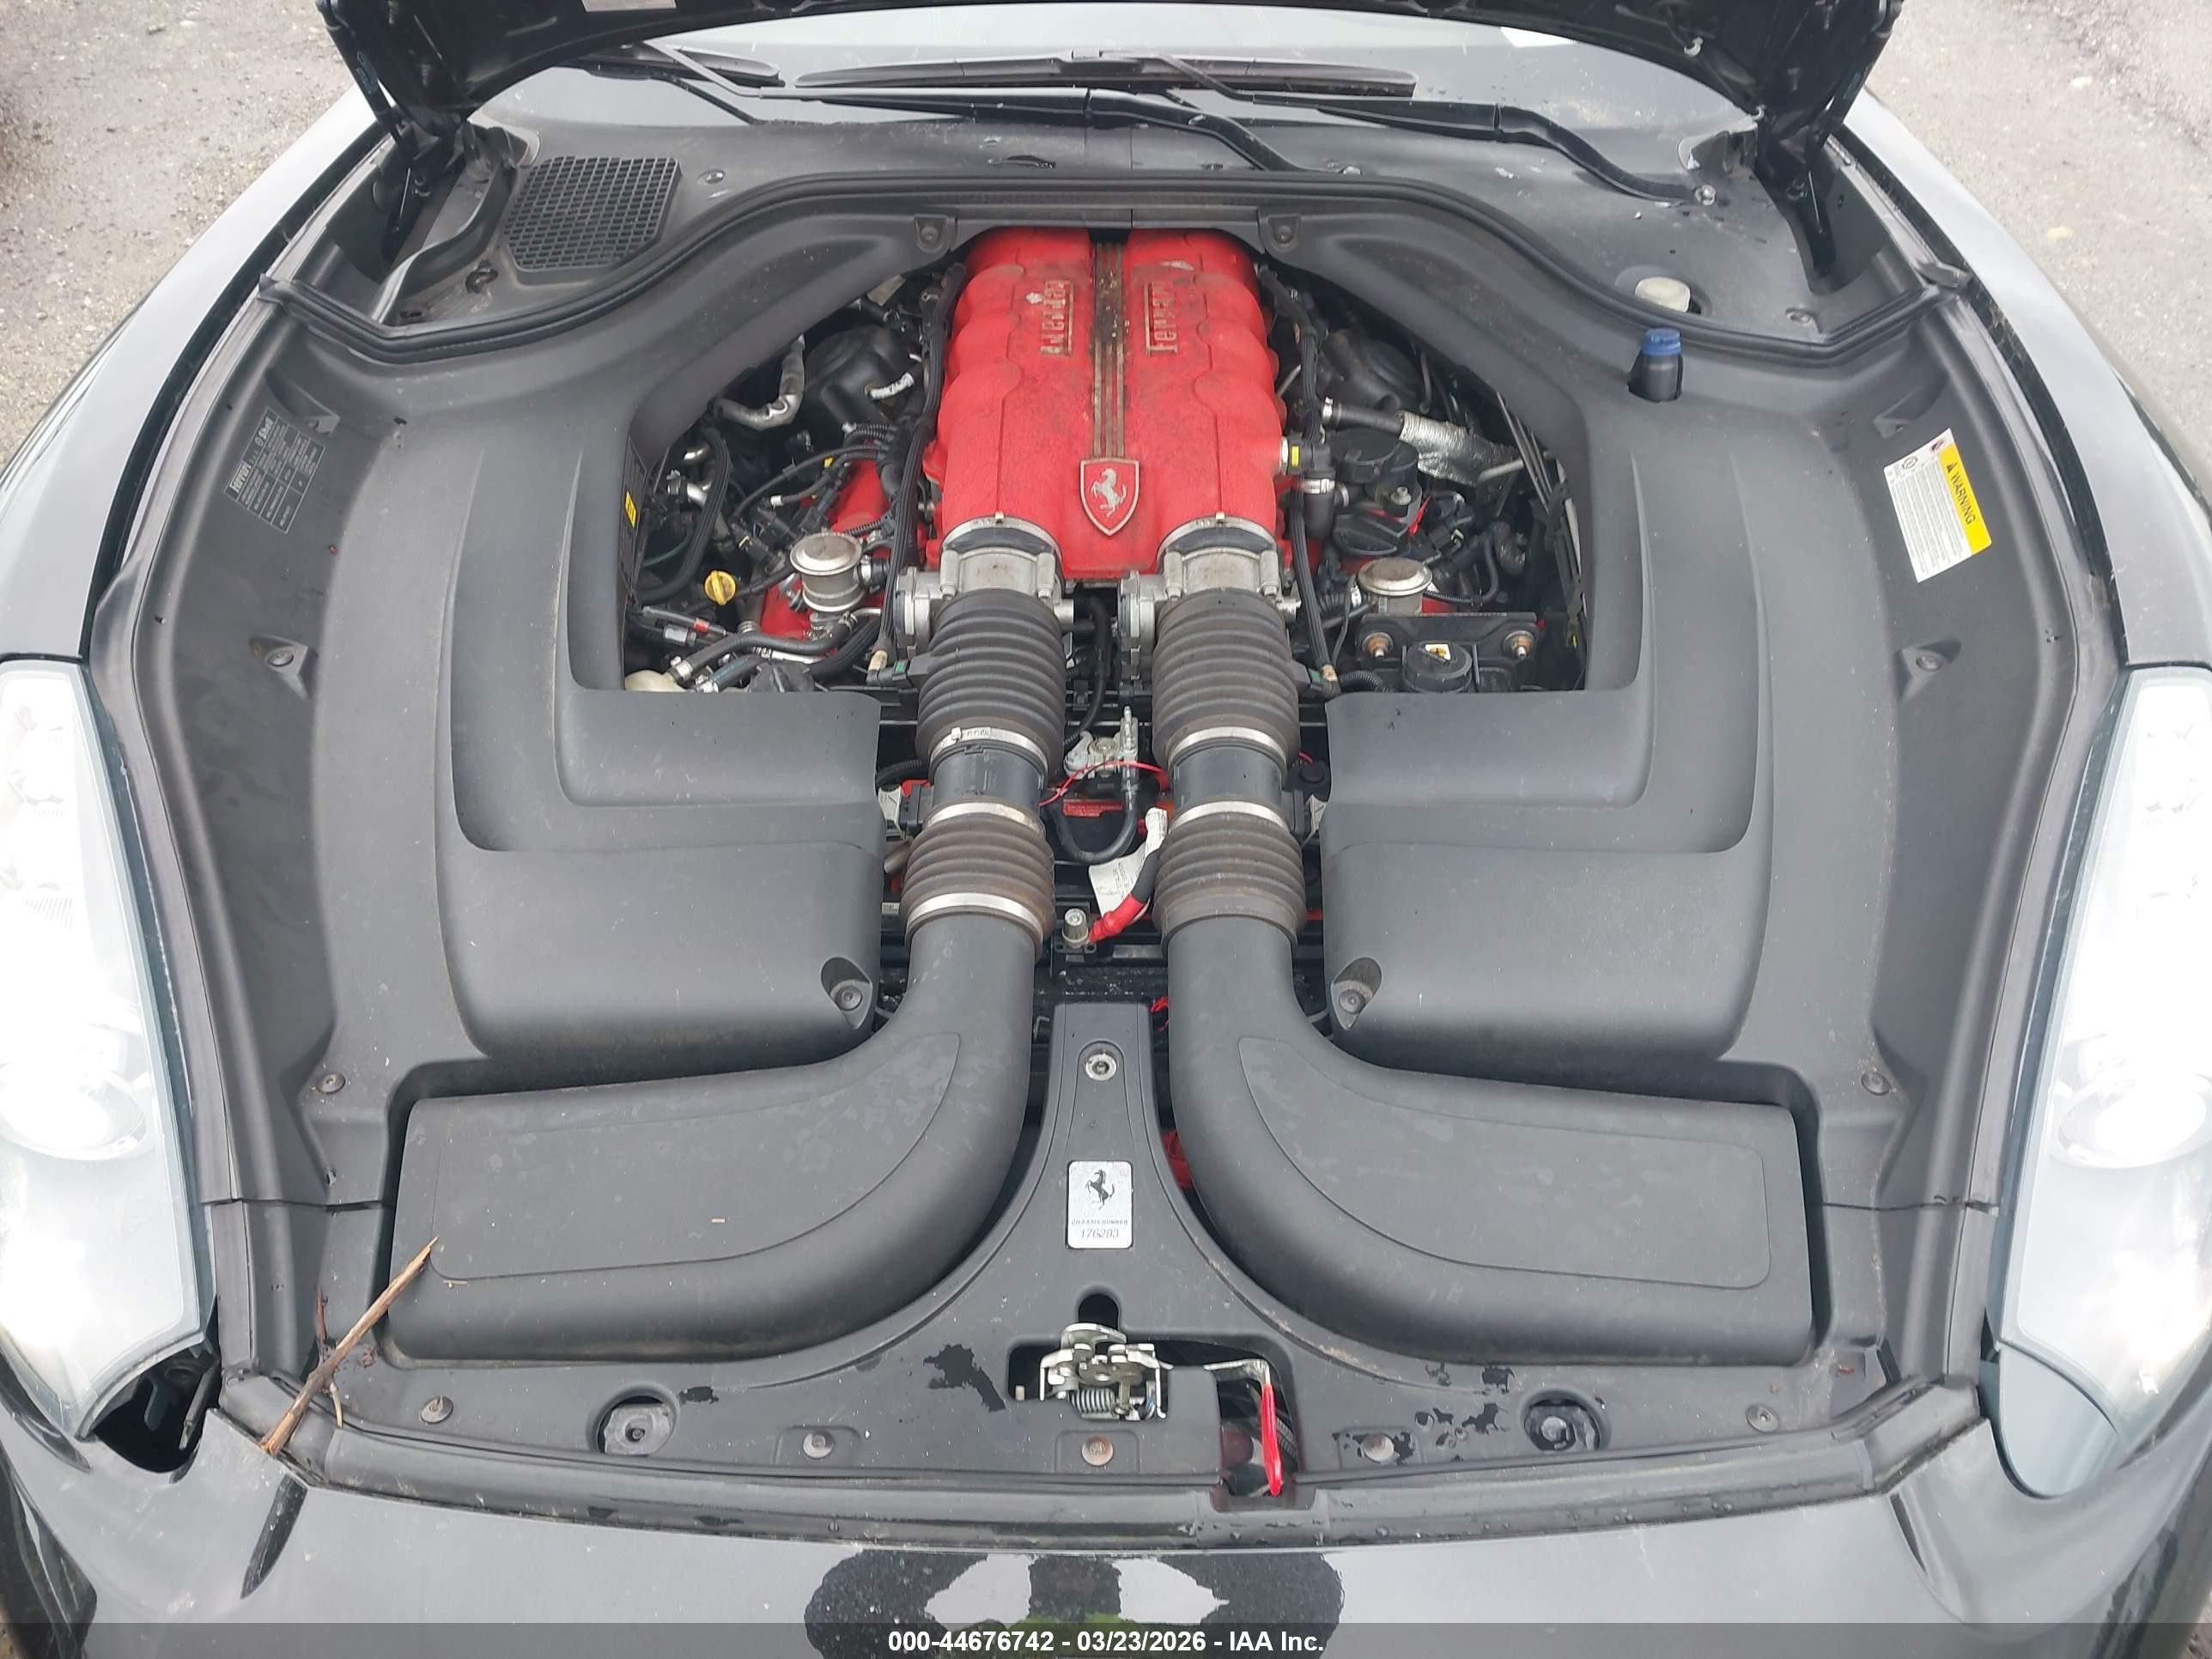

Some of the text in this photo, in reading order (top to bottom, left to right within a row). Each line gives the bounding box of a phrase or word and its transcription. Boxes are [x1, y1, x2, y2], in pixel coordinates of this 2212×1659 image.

[1040, 280, 1073, 356] Ferrari
[1145, 281, 1178, 356] Ferrari
[229, 459, 252, 494] Ferrari
[1950, 471, 1976, 526] WARNING
